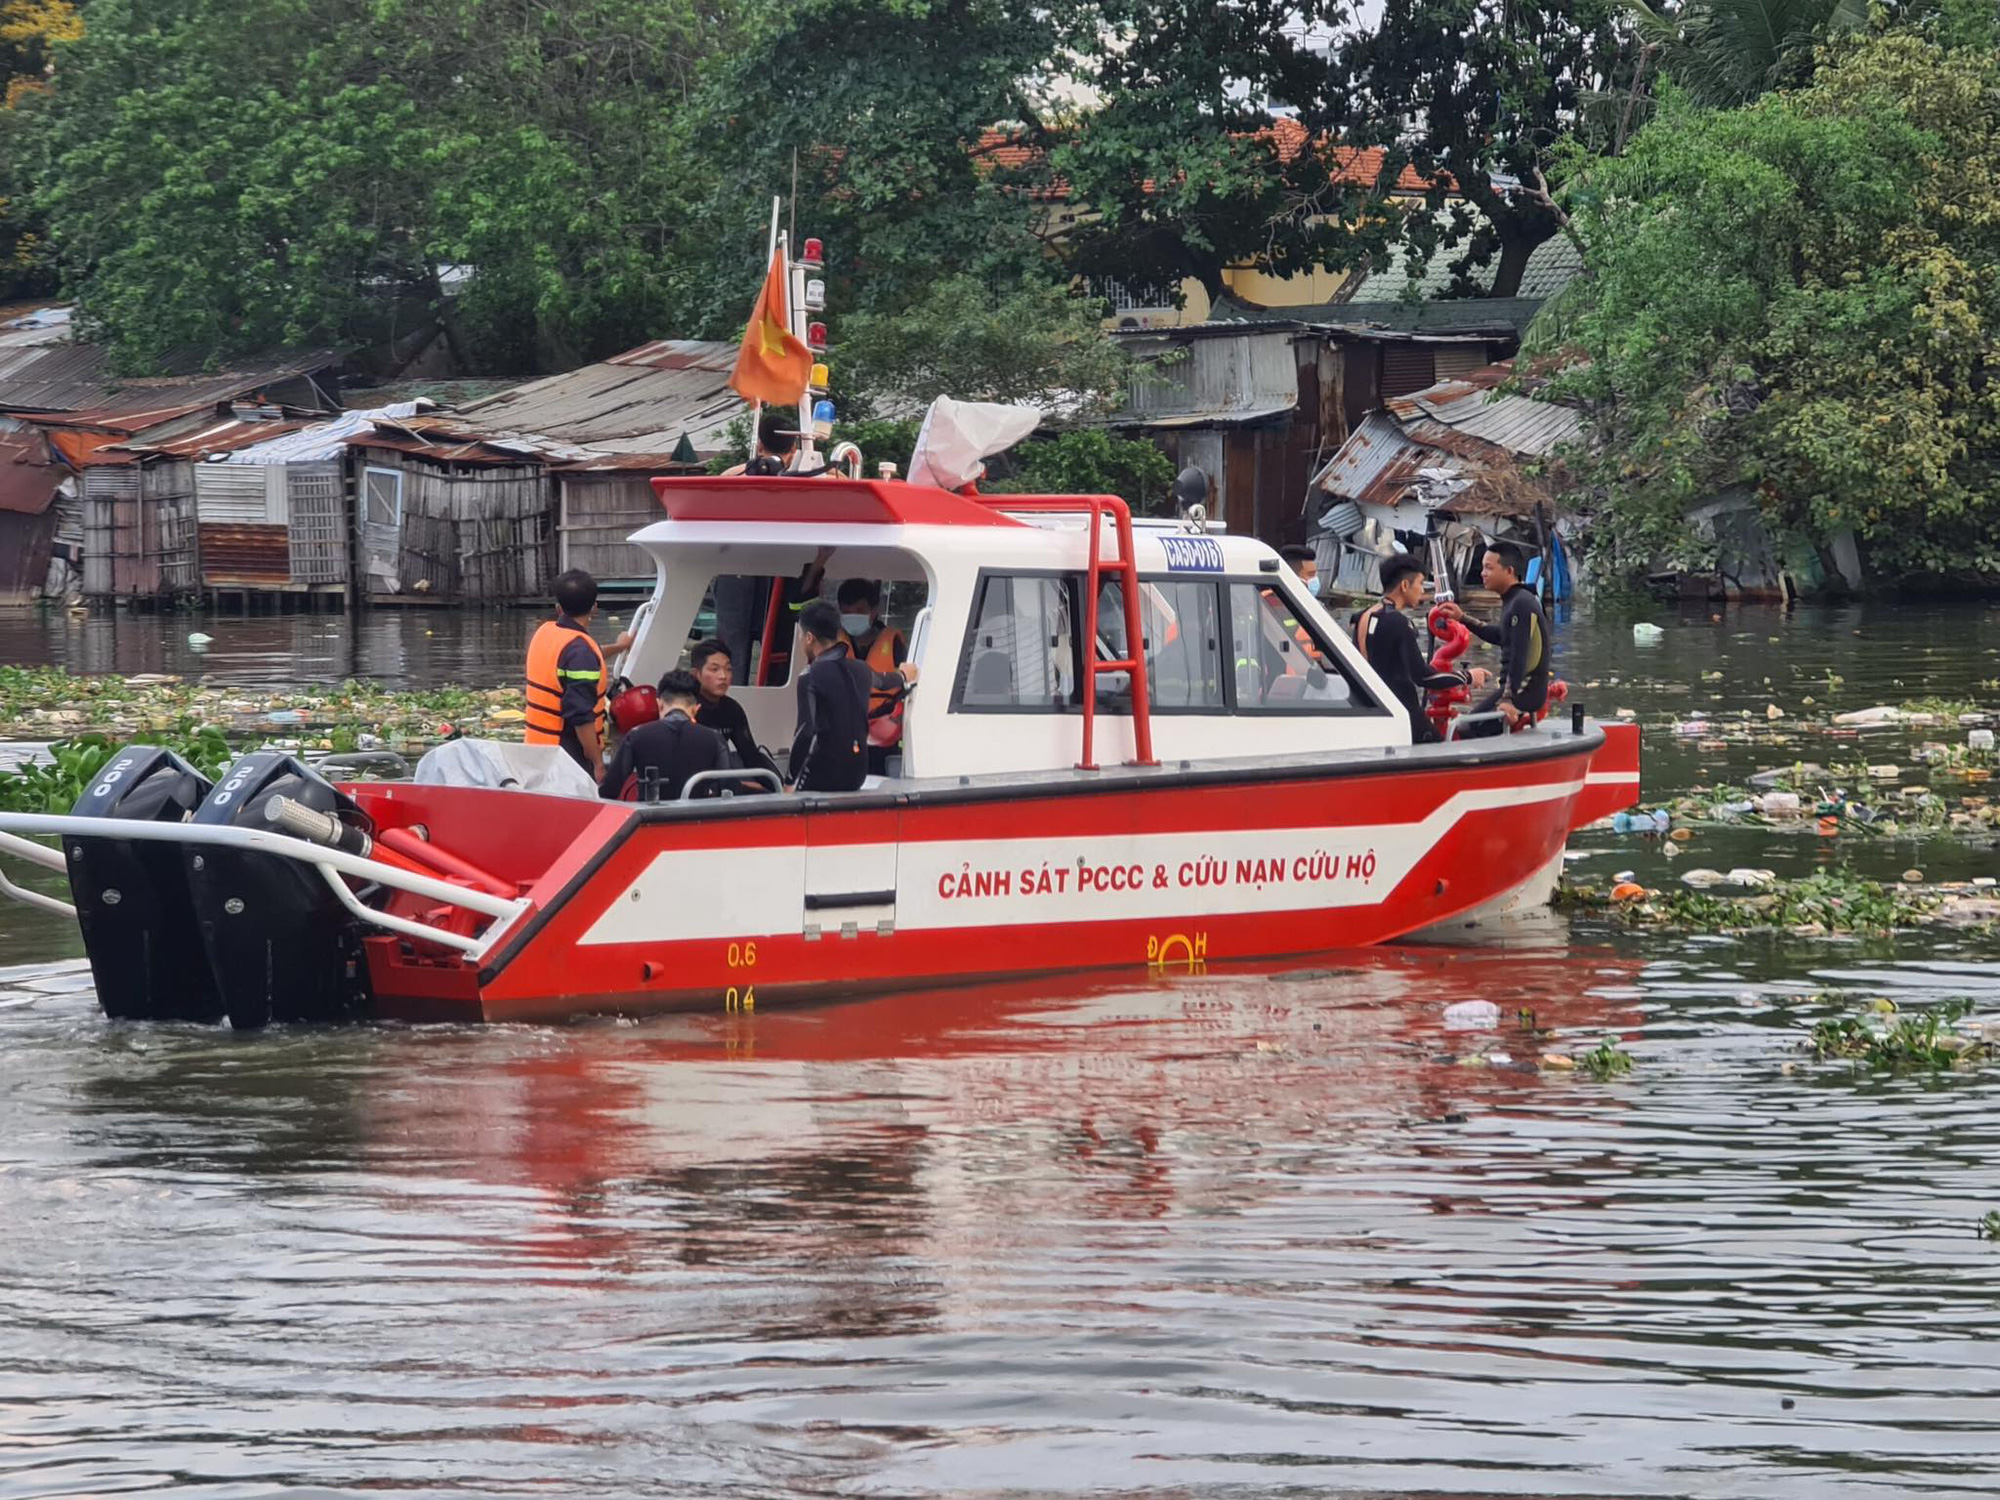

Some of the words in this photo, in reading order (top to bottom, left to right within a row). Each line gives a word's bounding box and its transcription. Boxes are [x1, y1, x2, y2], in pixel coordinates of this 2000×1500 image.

[93, 758, 133, 797] 200
[213, 766, 254, 805] 200
[938, 862, 1011, 899] CẢNH
[1019, 861, 1070, 895] SÁT
[1078, 864, 1144, 892] PCCC
[1152, 864, 1169, 889] &
[1178, 854, 1228, 887] CỨU
[1235, 858, 1286, 890] NẠN
[1293, 849, 1340, 881] CỨU
[1346, 848, 1376, 885] HỘ
[727, 941, 756, 967] 0.6
